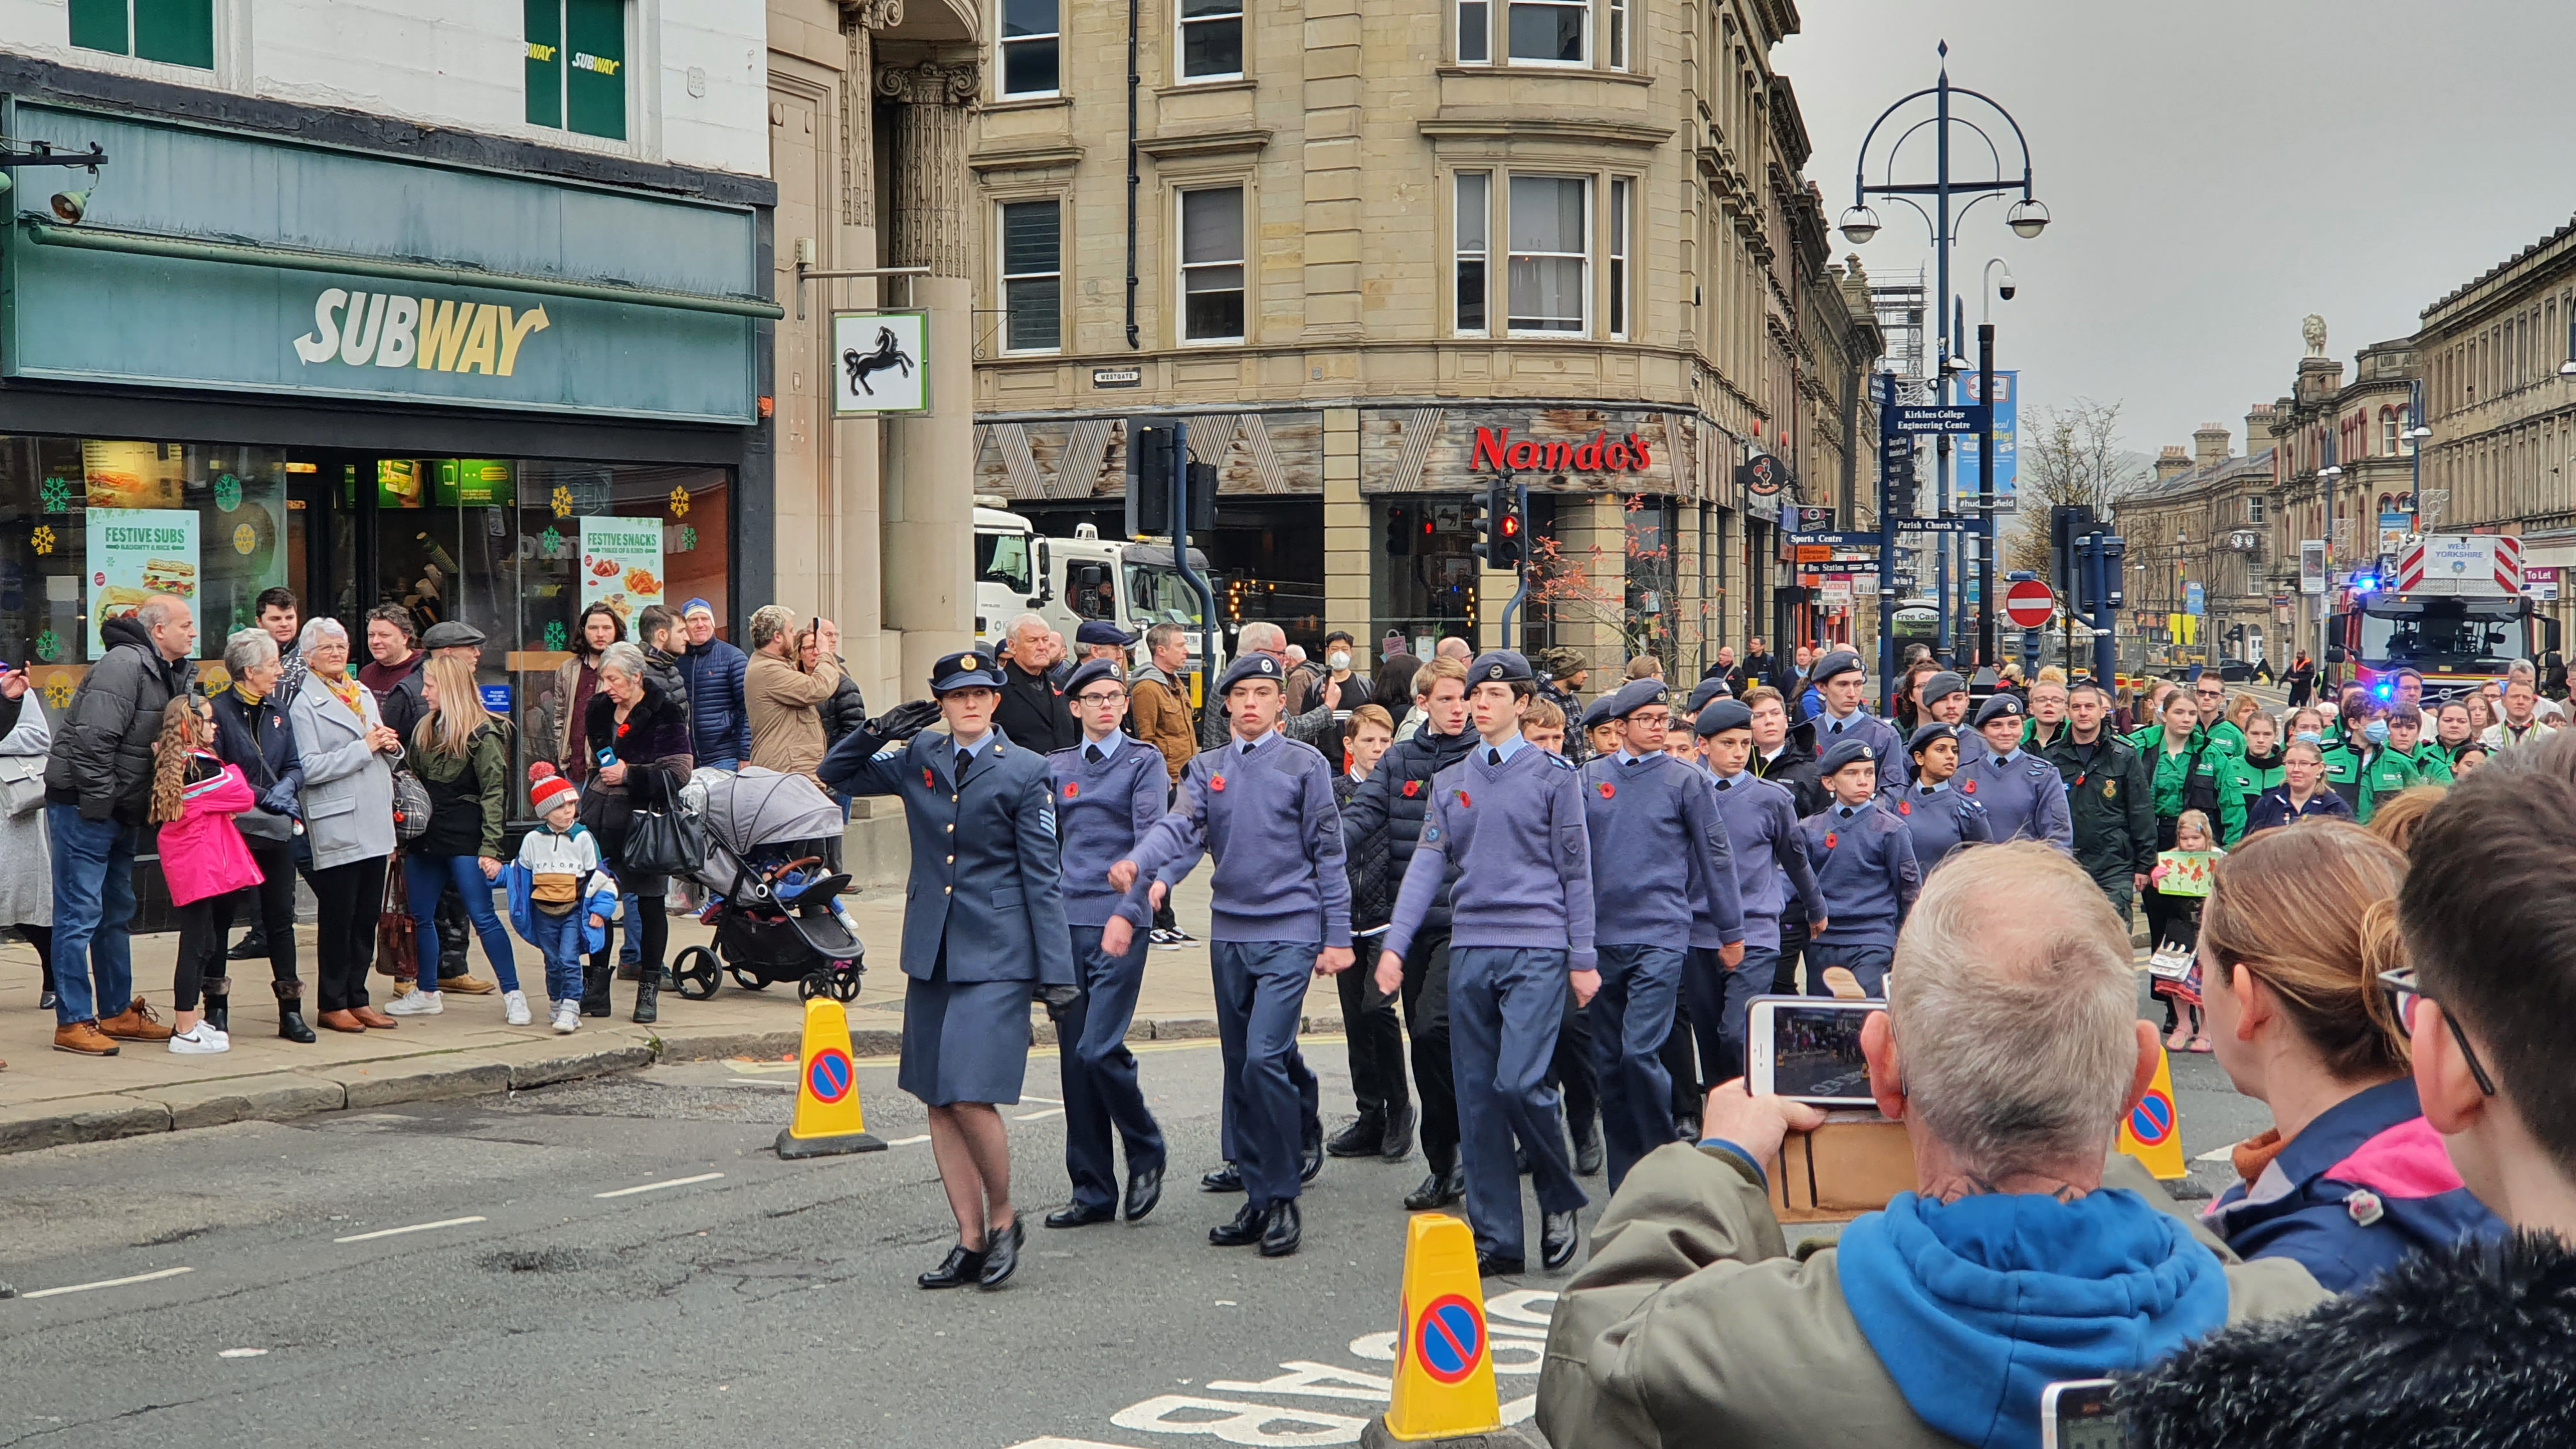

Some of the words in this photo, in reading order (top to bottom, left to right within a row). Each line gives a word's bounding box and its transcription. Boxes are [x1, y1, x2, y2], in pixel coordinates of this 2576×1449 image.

[572, 52, 620, 75] SUBWAY
[293, 288, 551, 377] SUBWAY
[1905, 410, 1936, 418] Kirklees
[1938, 410, 1965, 419] College
[1897, 421, 1943, 431] Engineering
[1945, 420, 1971, 429] Centre
[1468, 426, 1652, 473] Nando's
[1897, 521, 1922, 529] Parish
[1925, 521, 1952, 530] Church
[105, 527, 152, 542] FESTIVE
[154, 528, 185, 543] SUBS
[587, 532, 622, 546] FESTIVE
[623, 533, 657, 546] SNACKS
[1791, 535, 1814, 544] Sports
[1818, 534, 1843, 543] Centre
[1822, 564, 1844, 572] Station
[2526, 571, 2536, 579] To
[2538, 571, 2551, 579] Let
